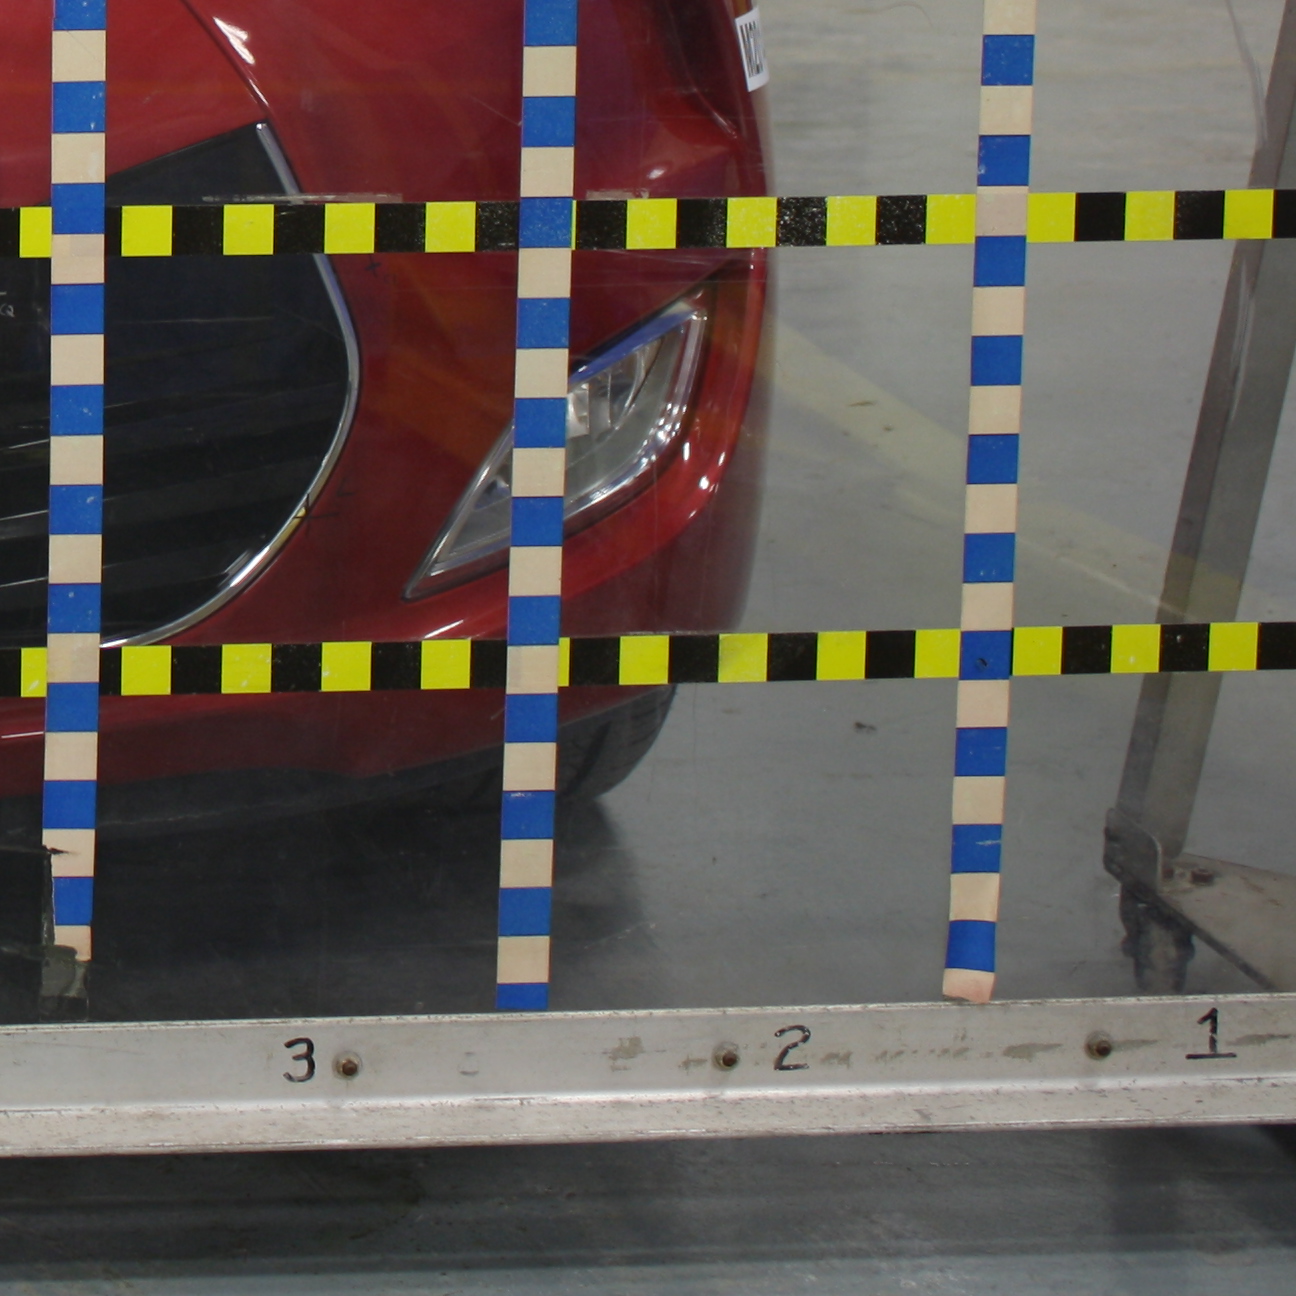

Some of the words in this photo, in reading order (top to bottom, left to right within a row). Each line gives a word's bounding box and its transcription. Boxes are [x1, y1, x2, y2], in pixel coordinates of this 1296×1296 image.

[774, 1025, 811, 1071] 2
[1185, 1007, 1237, 1060] 1
[283, 1037, 316, 1083] 3
